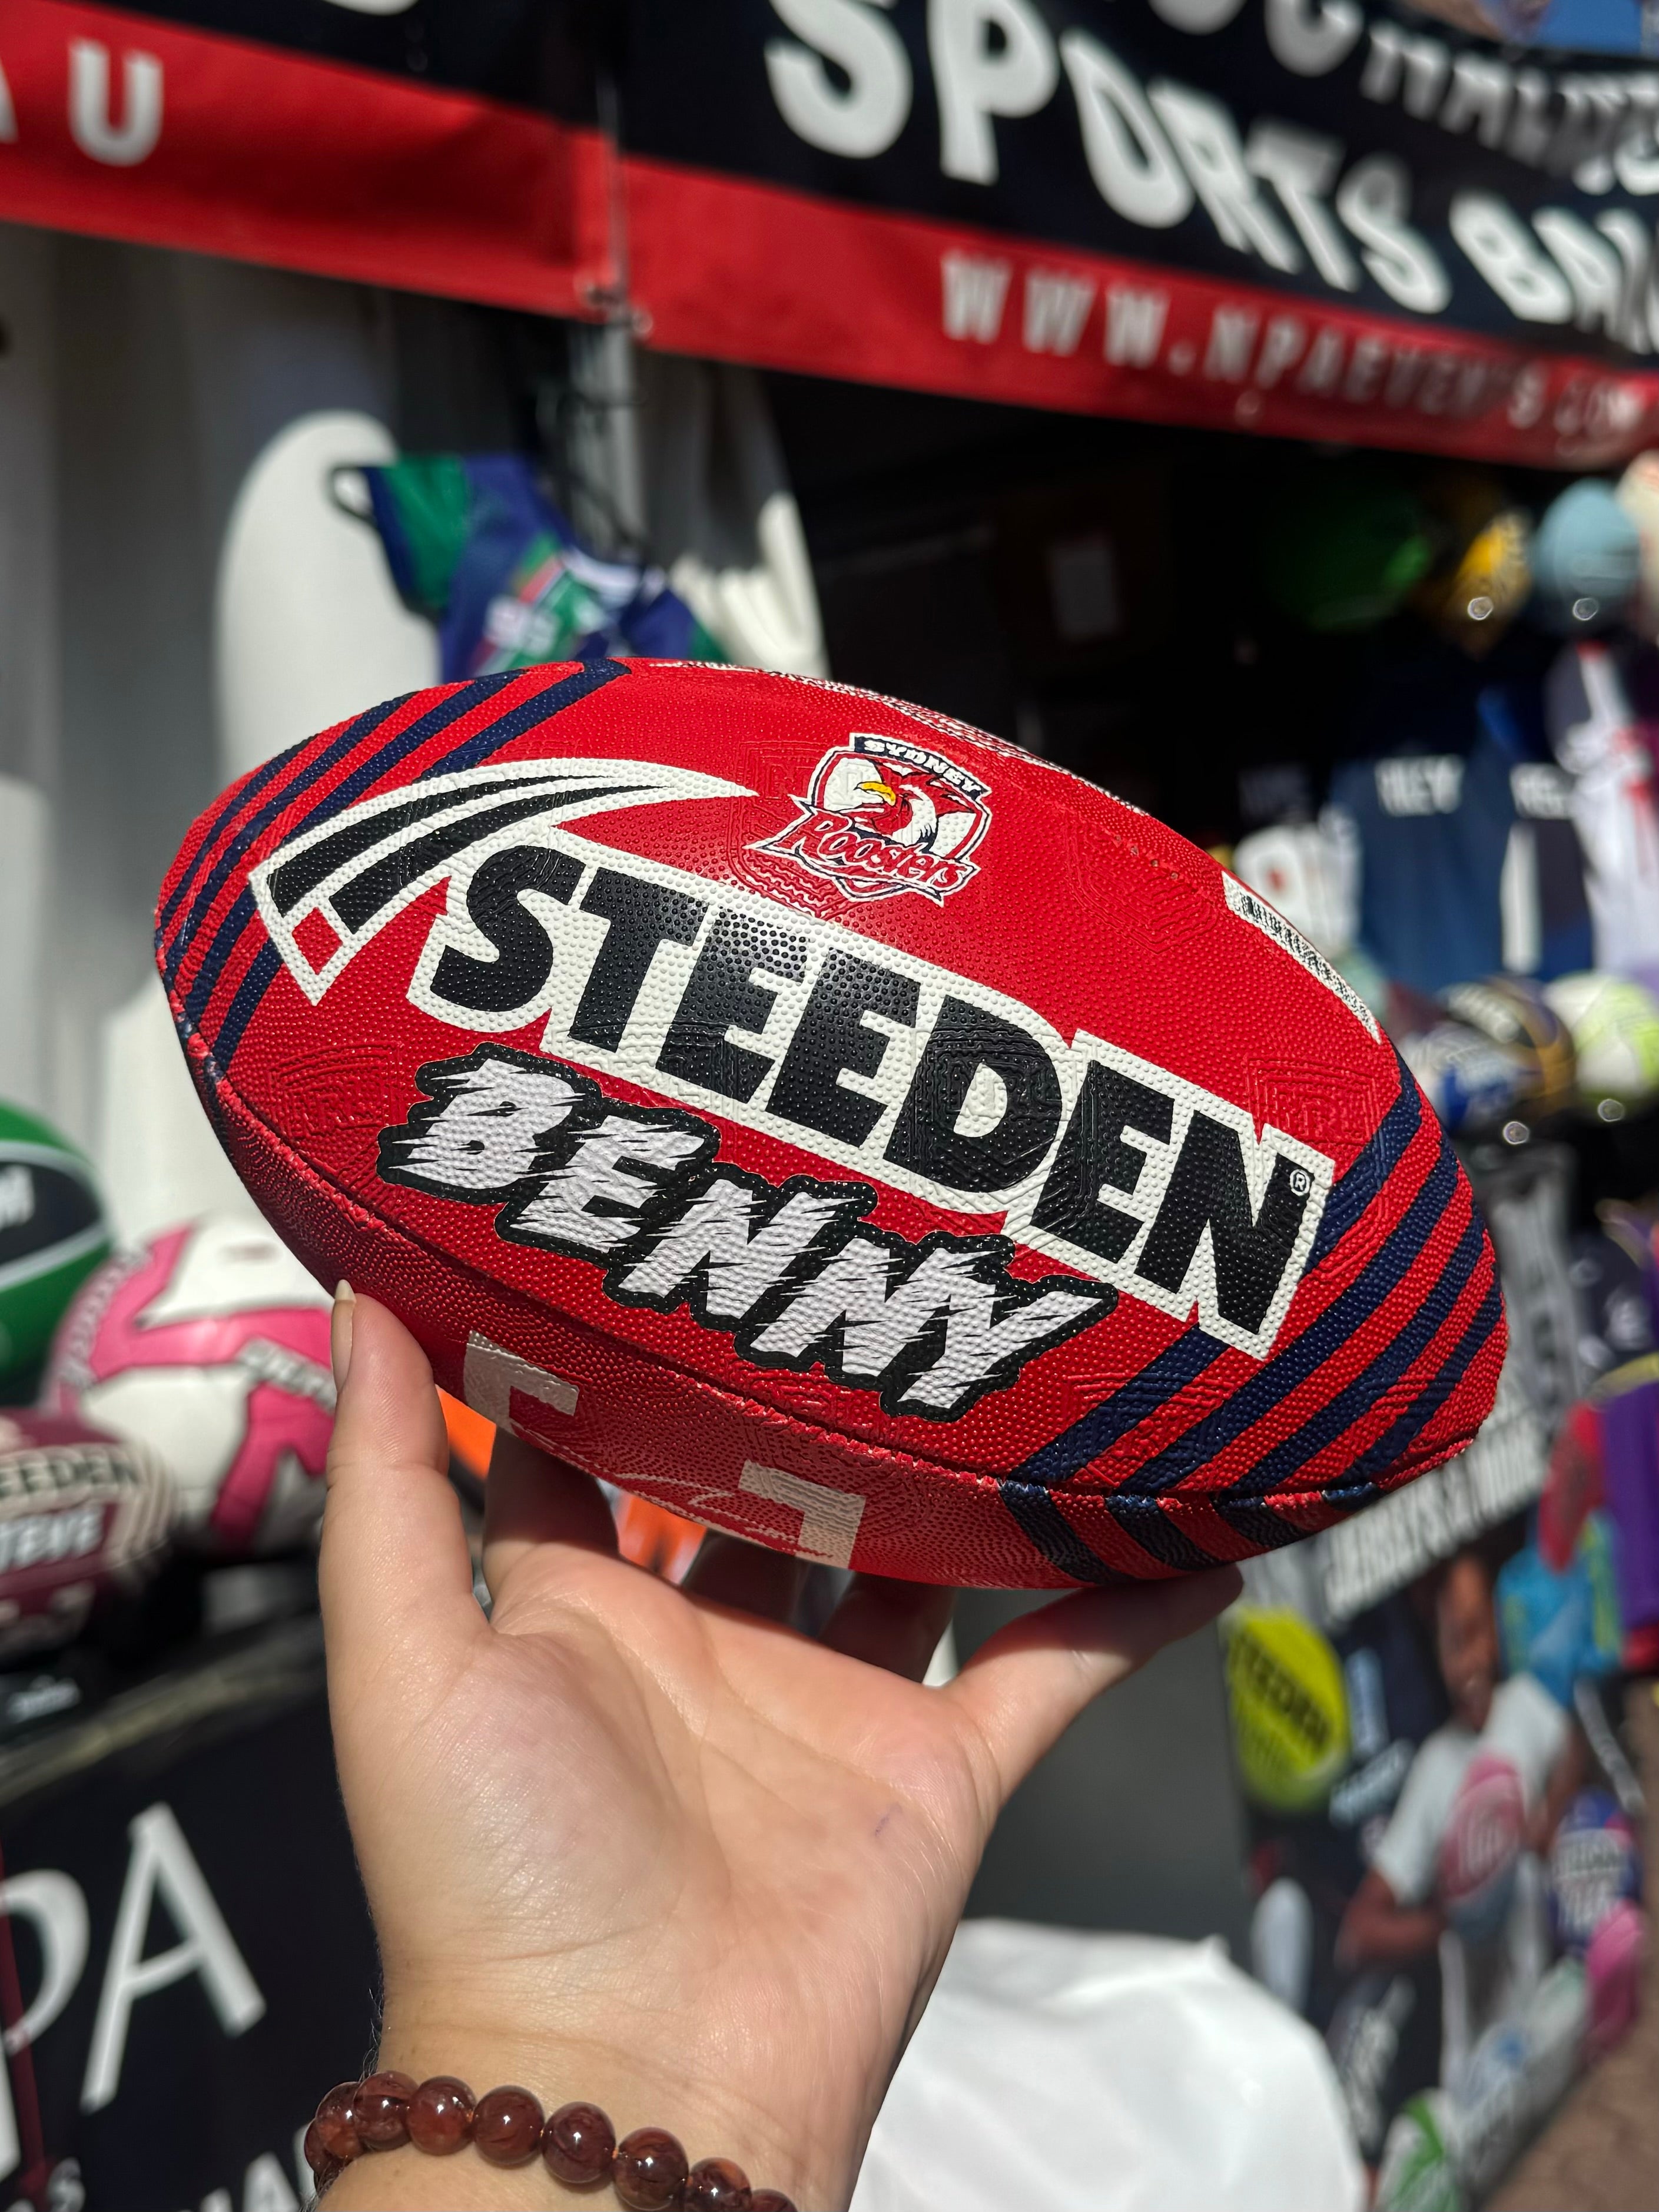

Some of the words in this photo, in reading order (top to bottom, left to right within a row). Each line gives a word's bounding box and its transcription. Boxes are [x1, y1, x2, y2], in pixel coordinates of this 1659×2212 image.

[764, 0, 1452, 314] SPORTS
[864, 739, 982, 793] SYDNEY
[404, 1060, 1111, 1410] BENNY
[432, 844, 1315, 1335] STEEDEN
